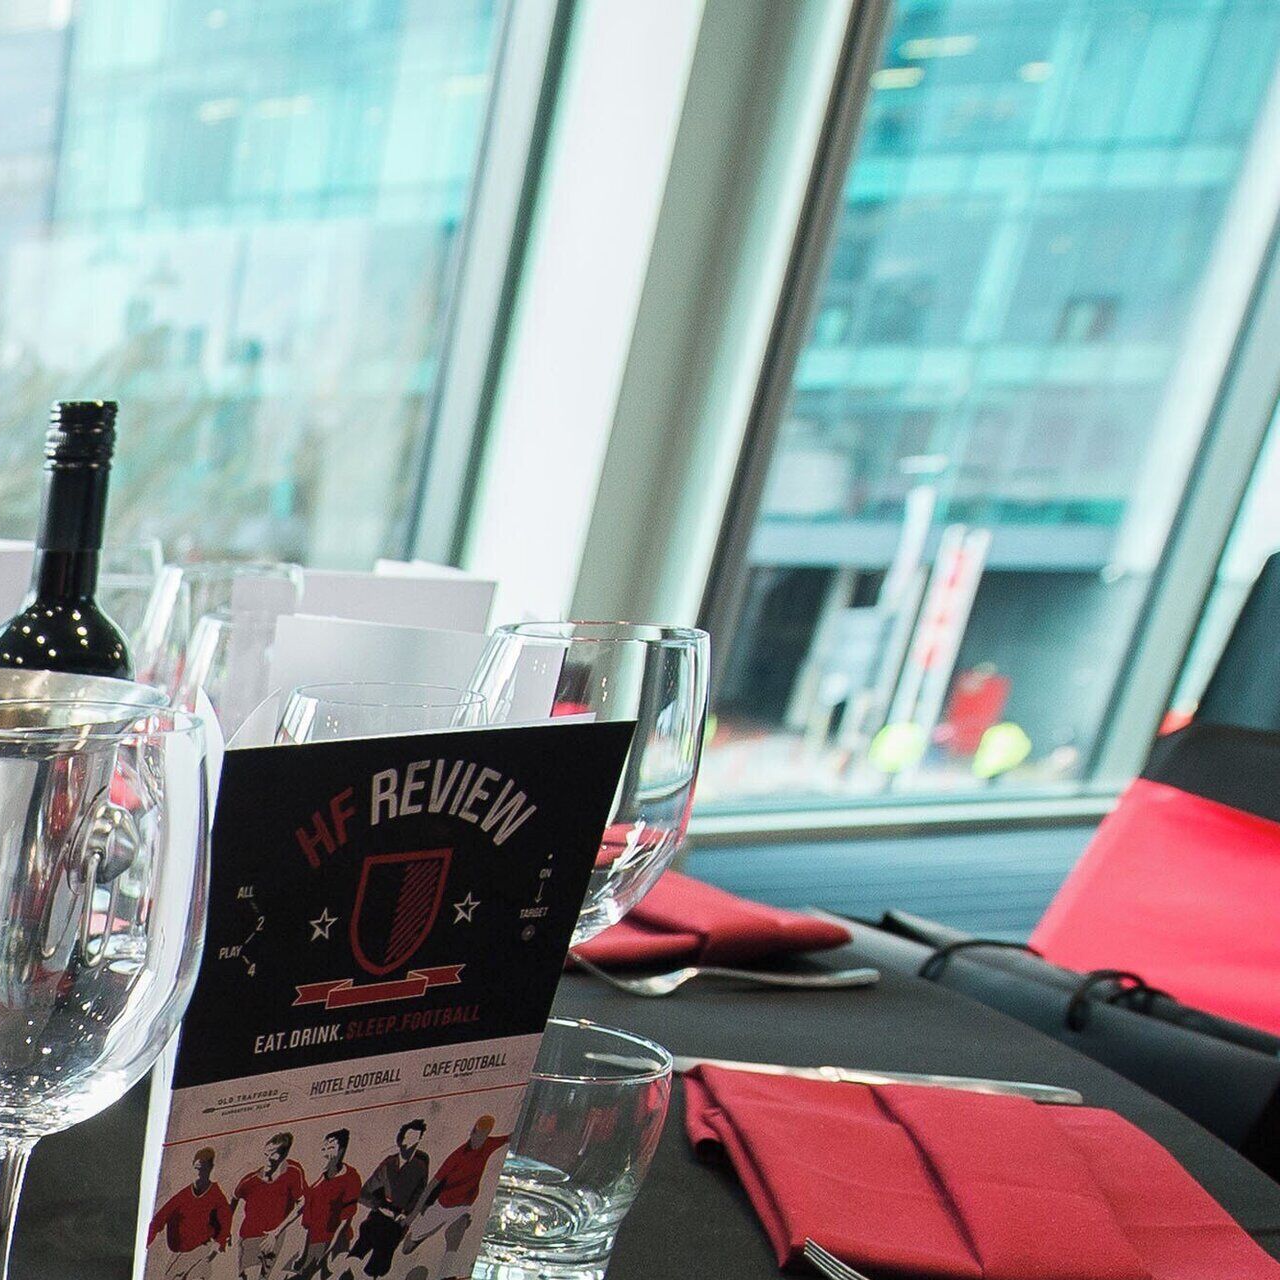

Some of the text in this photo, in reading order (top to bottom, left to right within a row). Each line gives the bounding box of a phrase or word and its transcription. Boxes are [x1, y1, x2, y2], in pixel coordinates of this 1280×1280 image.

[294, 758, 538, 869] HF REVIEW
[540, 868, 552, 879] ON
[237, 886, 254, 899] ALL
[256, 915, 265, 931] 2
[219, 945, 243, 960] PLAY
[247, 963, 256, 977] 4
[422, 1060, 452, 1078] CAFE
[452, 1053, 507, 1074] FOOTBALL
[309, 1067, 401, 1096] HOTEL FOOTBALL
[217, 1088, 279, 1105] OLD TRAFFORD
